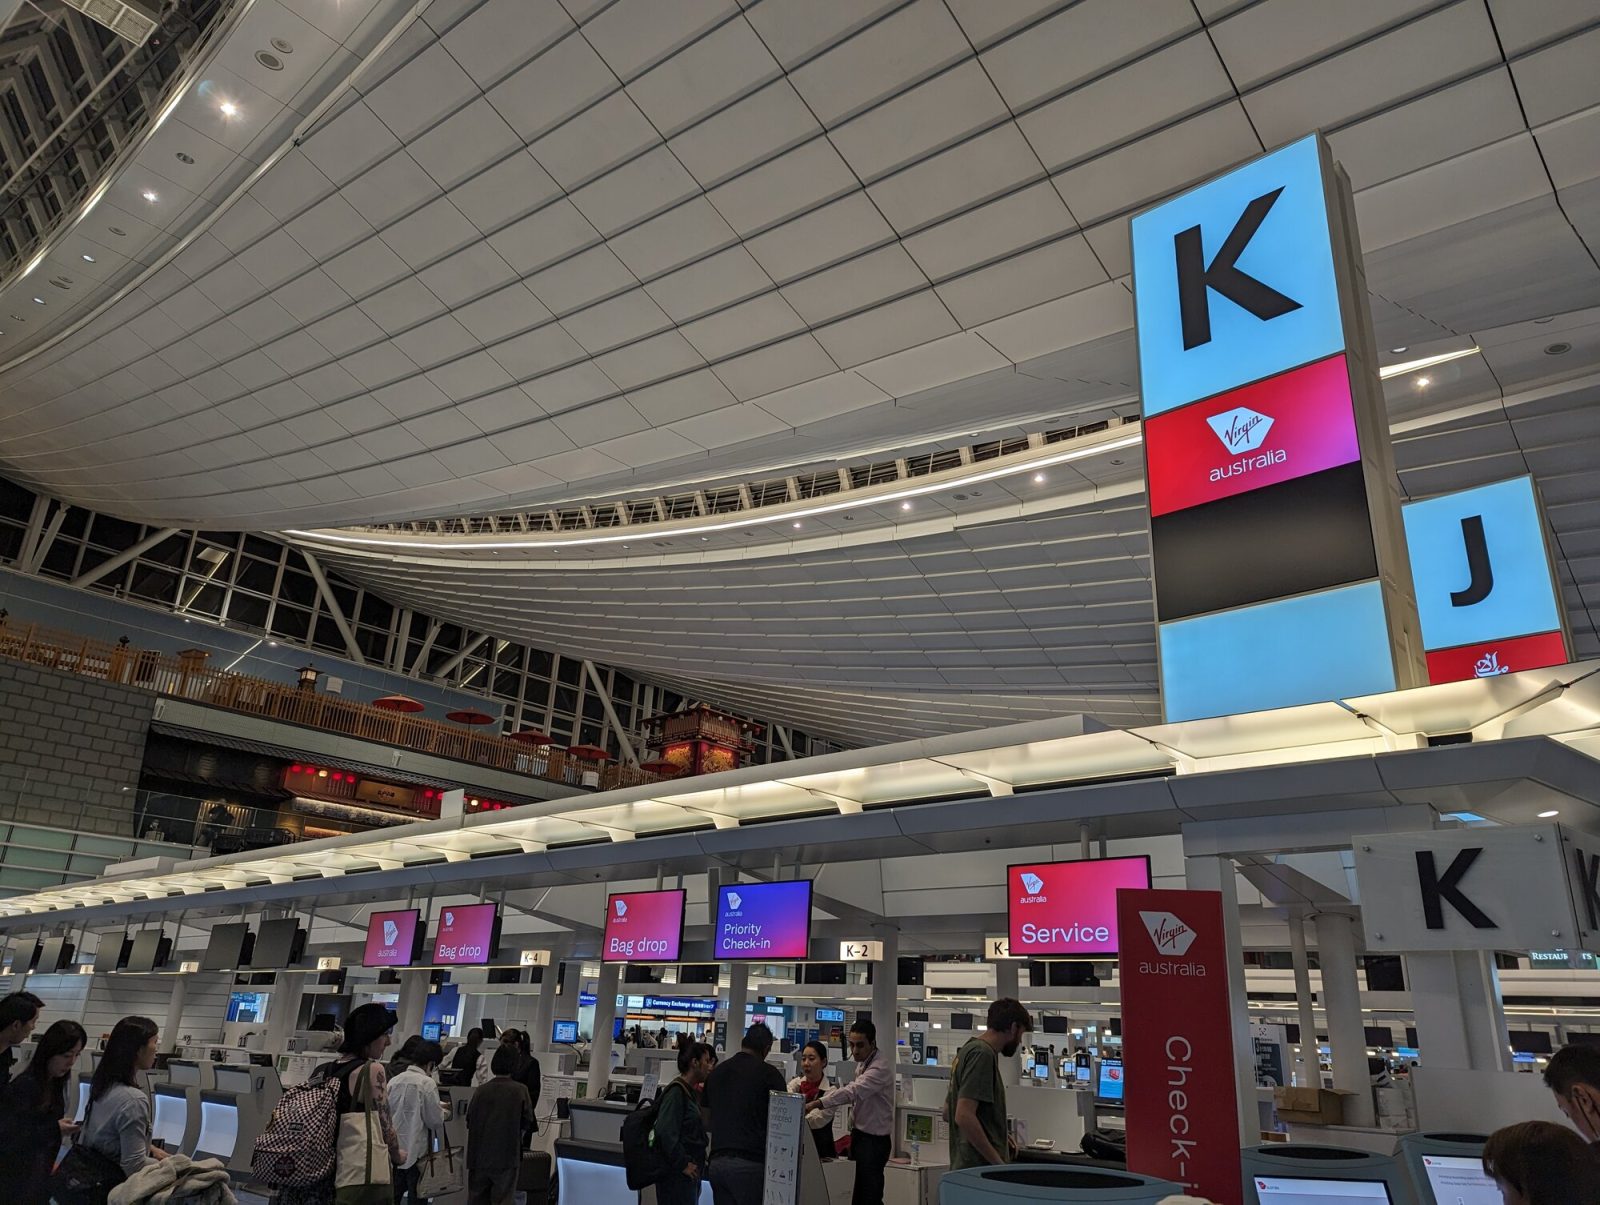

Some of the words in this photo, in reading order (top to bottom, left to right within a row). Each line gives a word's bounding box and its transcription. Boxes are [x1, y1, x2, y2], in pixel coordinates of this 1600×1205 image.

[1174, 185, 1304, 351] K
[1224, 416, 1263, 447] Virgin
[1209, 449, 1287, 481] australia
[1450, 514, 1493, 607] J
[1415, 847, 1499, 929] K
[1020, 895, 1047, 903] australia
[724, 923, 762, 936] Priority
[1021, 922, 1109, 944] Service
[1153, 918, 1187, 949] Virgin
[439, 944, 457, 960] Bag
[459, 943, 481, 959] drop
[610, 937, 634, 956] Bag
[637, 936, 668, 955] drop
[723, 938, 771, 949] Check-in
[846, 944, 868, 957] K-2
[994, 942, 1008, 955] K-
[524, 952, 539, 963] K-4
[1139, 961, 1206, 977] australia
[652, 999, 671, 1008] Currency
[671, 1000, 690, 1008] Exchange
[1165, 1035, 1199, 1189] Check-i
